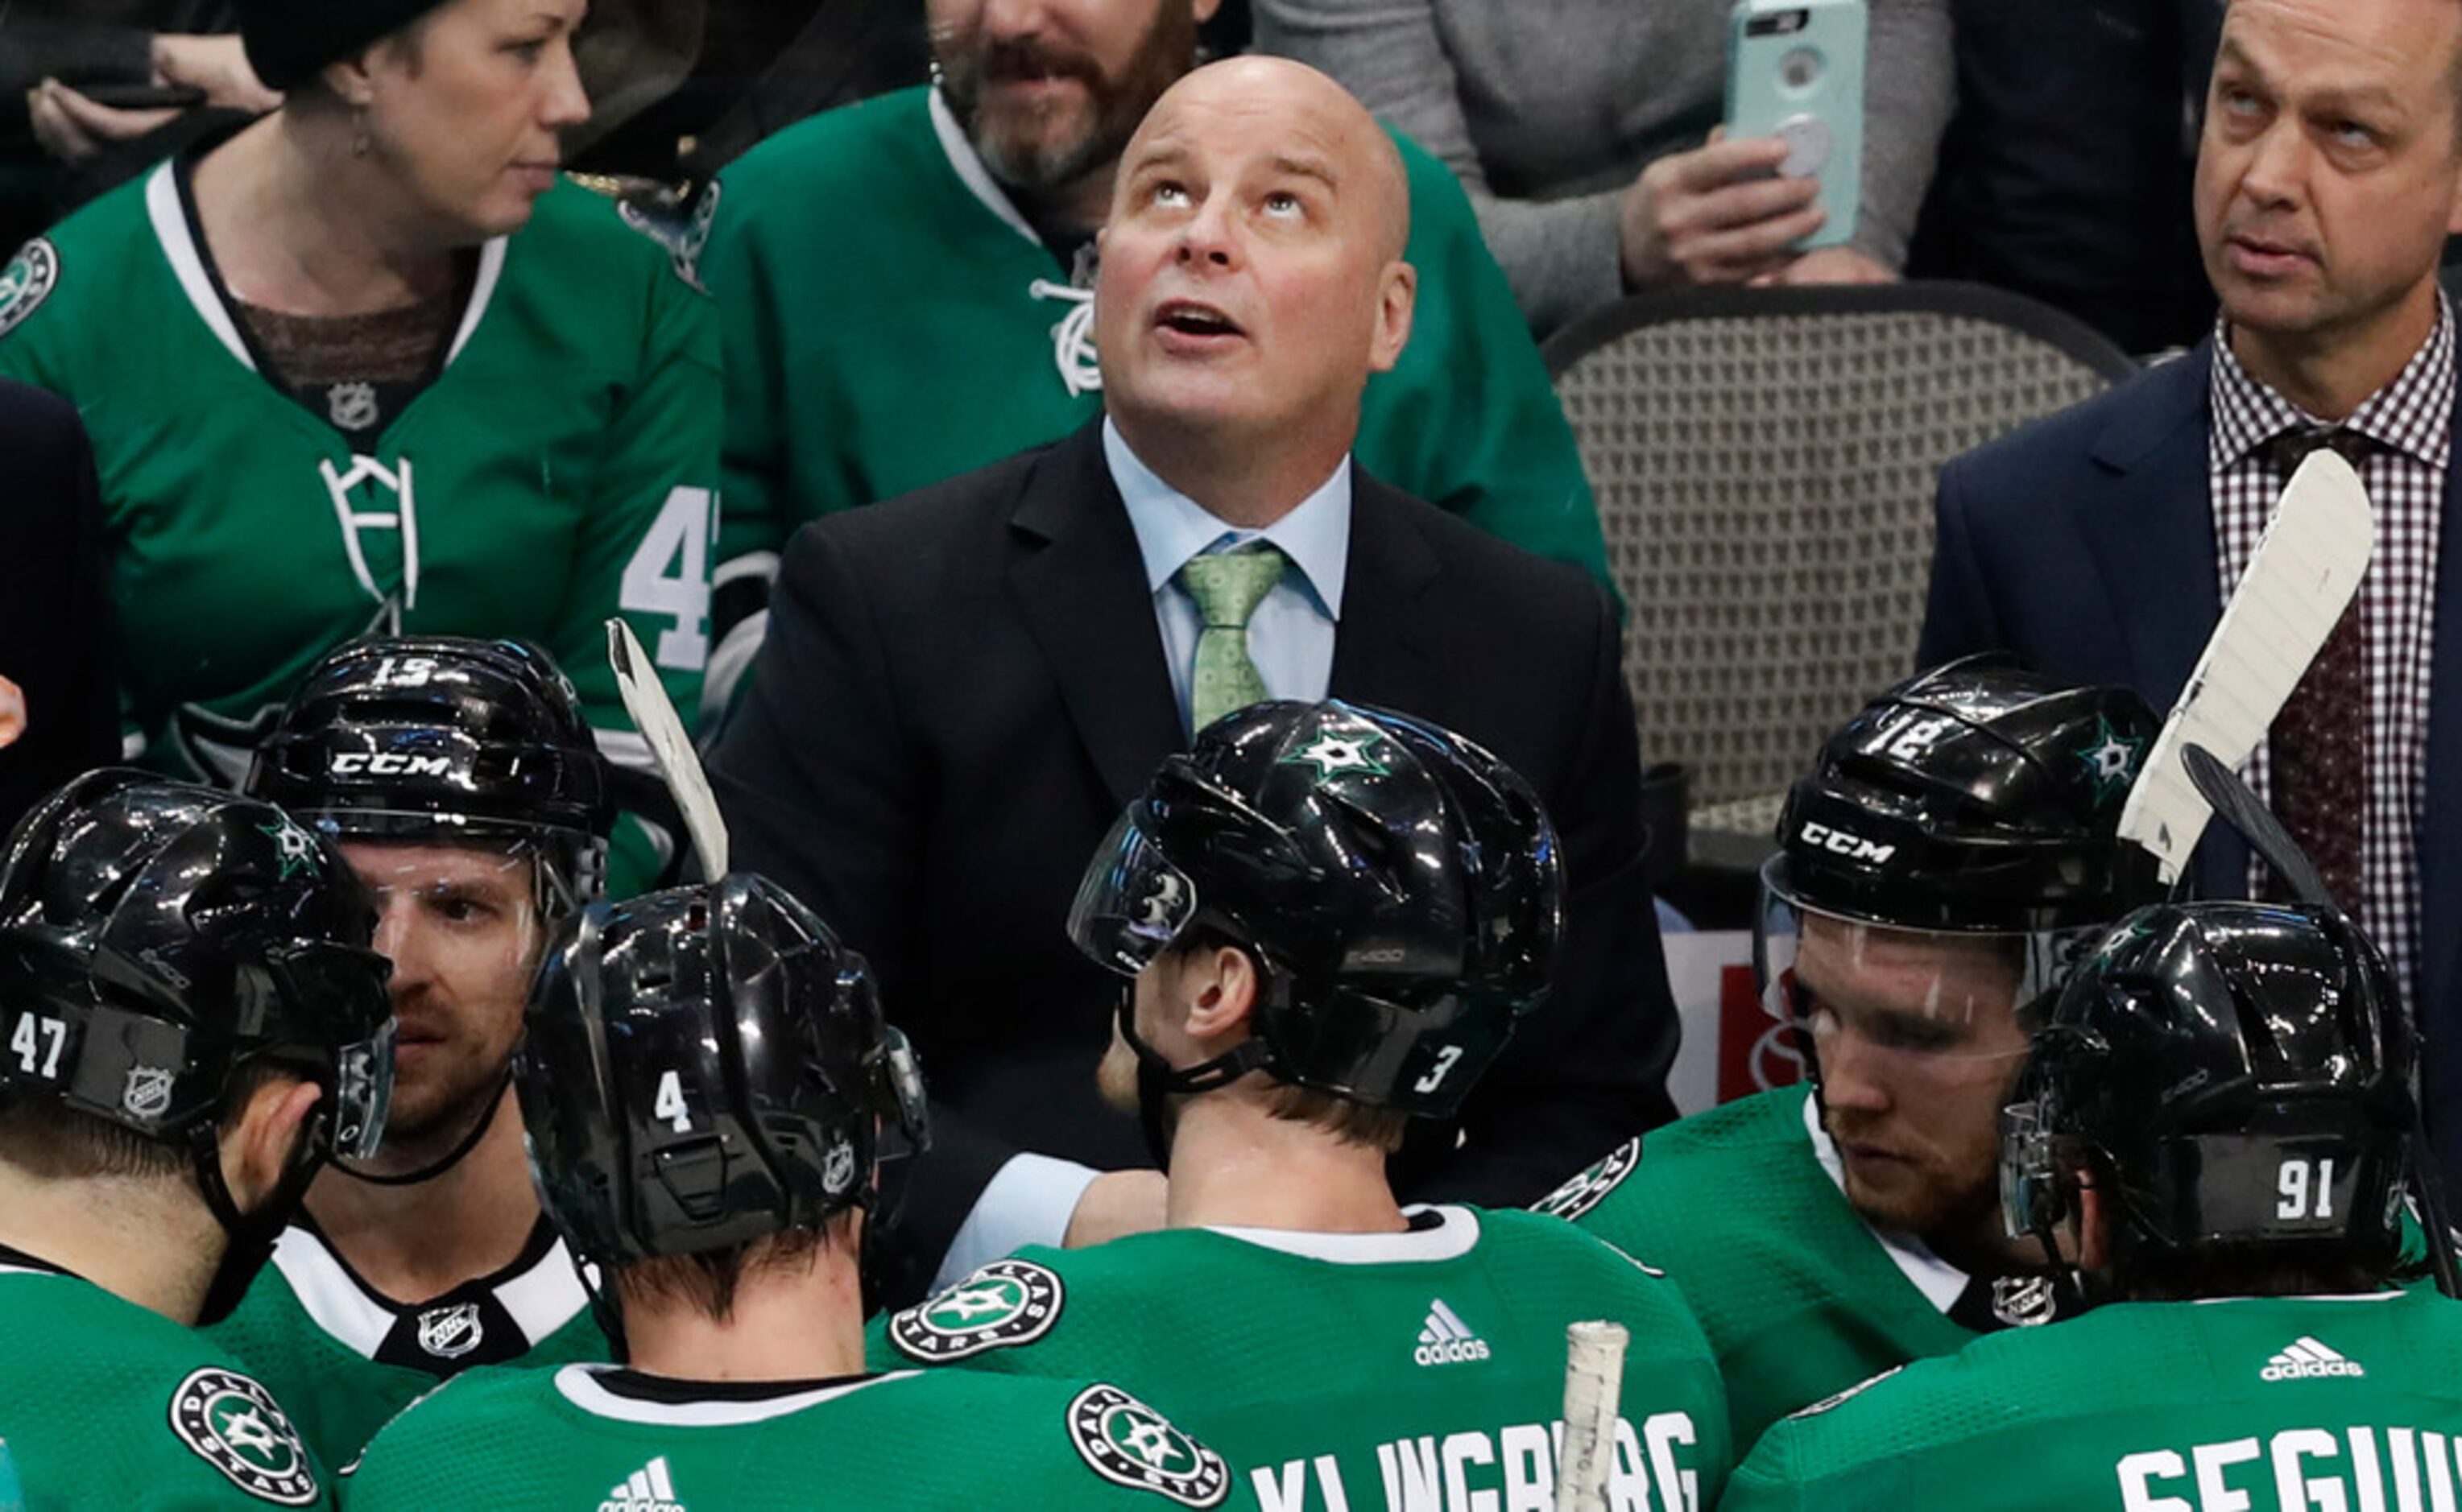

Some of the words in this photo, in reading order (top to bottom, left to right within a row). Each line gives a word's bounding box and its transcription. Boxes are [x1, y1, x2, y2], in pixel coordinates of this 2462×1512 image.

[330, 753, 451, 775] CCM
[1800, 820, 1896, 864] CCM
[10, 1011, 66, 1080] 47
[1413, 1045, 1463, 1093] 3
[655, 1069, 693, 1133] 4
[2277, 1159, 2333, 1220] 91
[1414, 1338, 1490, 1365] adidas
[2260, 1359, 2365, 1382] adidas
[1249, 1412, 1698, 1512] INGBRG
[2116, 1426, 2462, 1512] SEGUI
